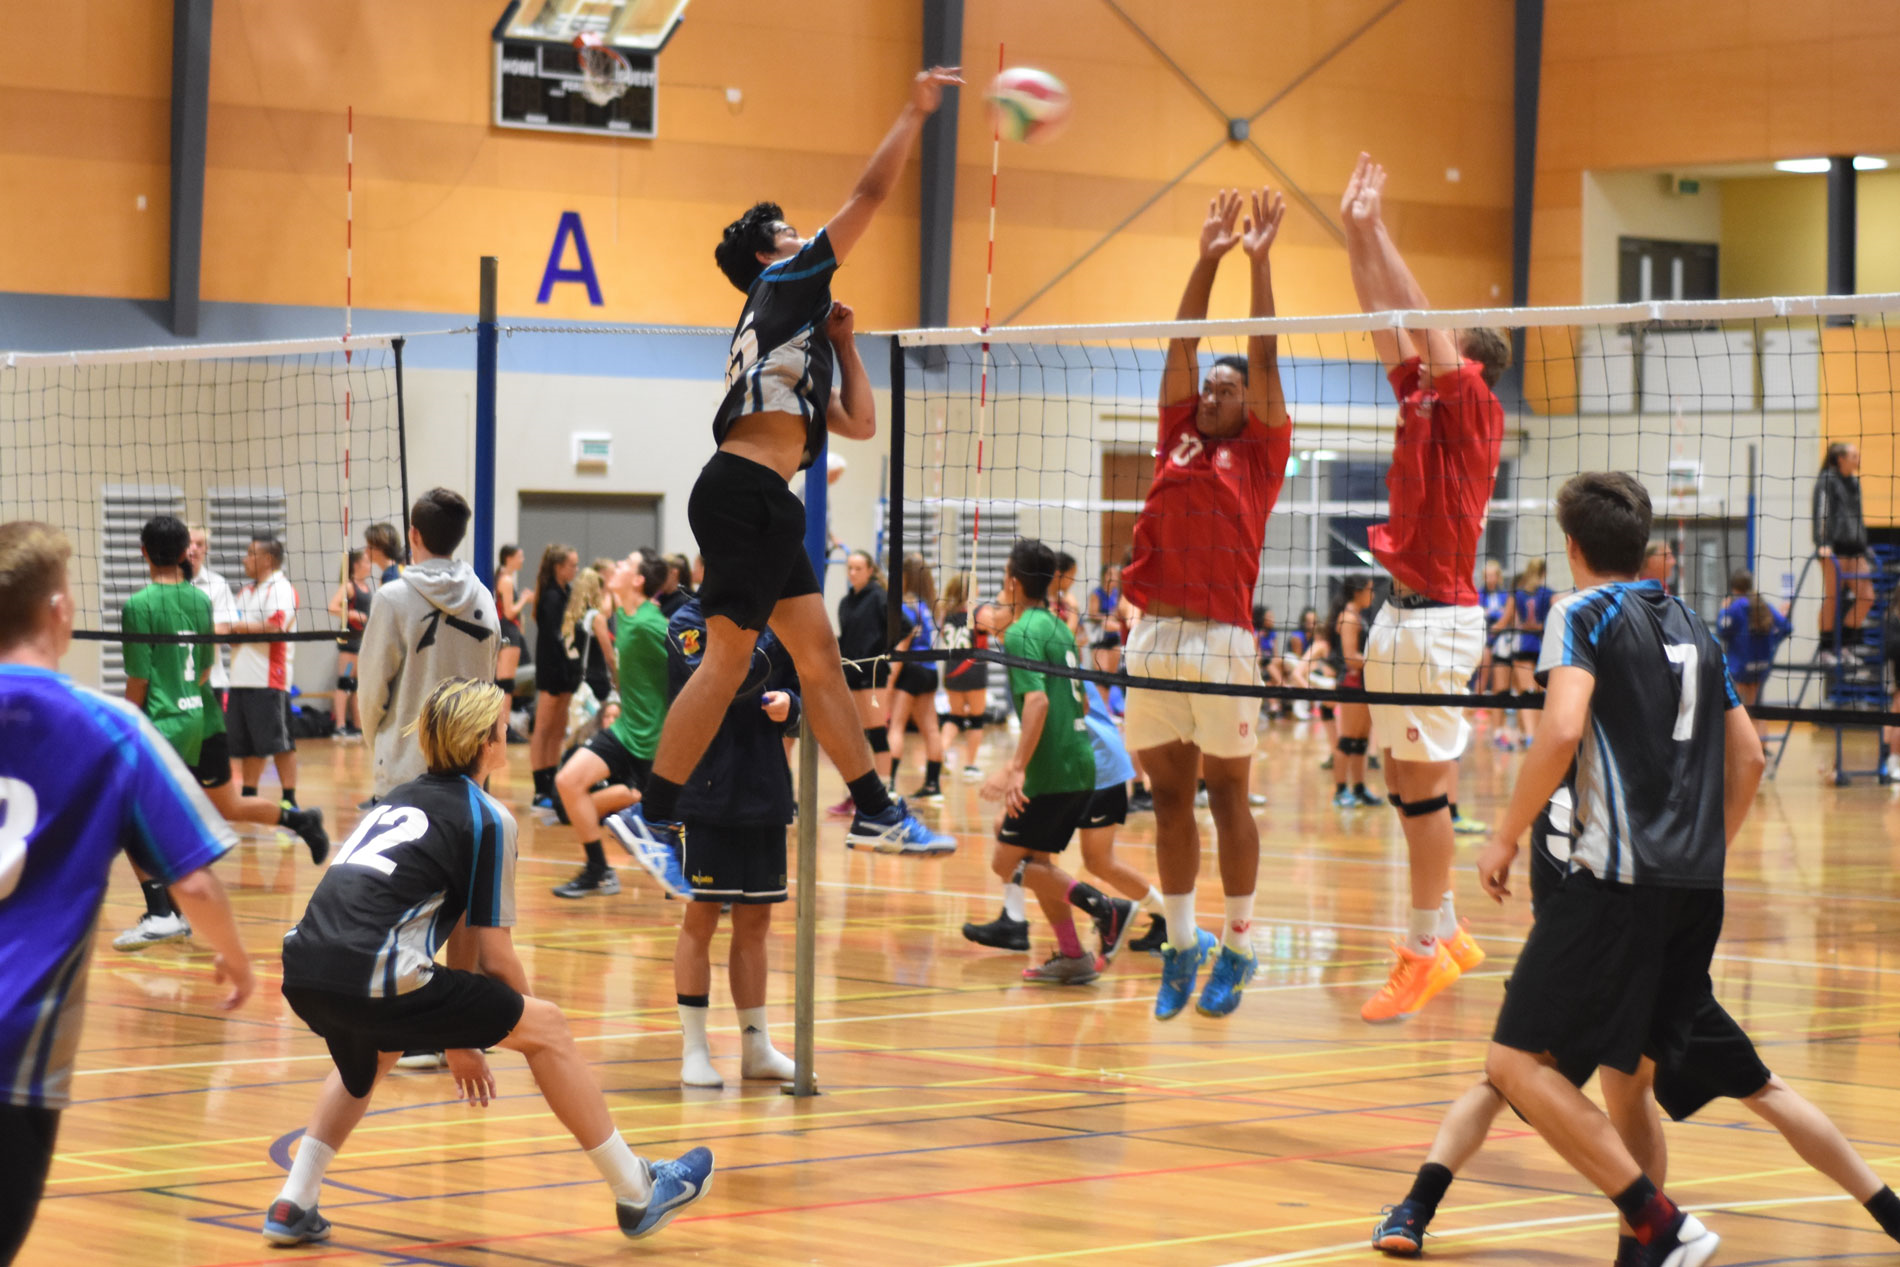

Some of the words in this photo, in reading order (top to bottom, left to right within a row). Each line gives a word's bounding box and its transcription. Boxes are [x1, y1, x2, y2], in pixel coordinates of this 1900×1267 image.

[502, 58, 536, 77] HOME
[536, 210, 605, 307] A
[1663, 643, 1698, 741] 7
[330, 804, 430, 876] 12
